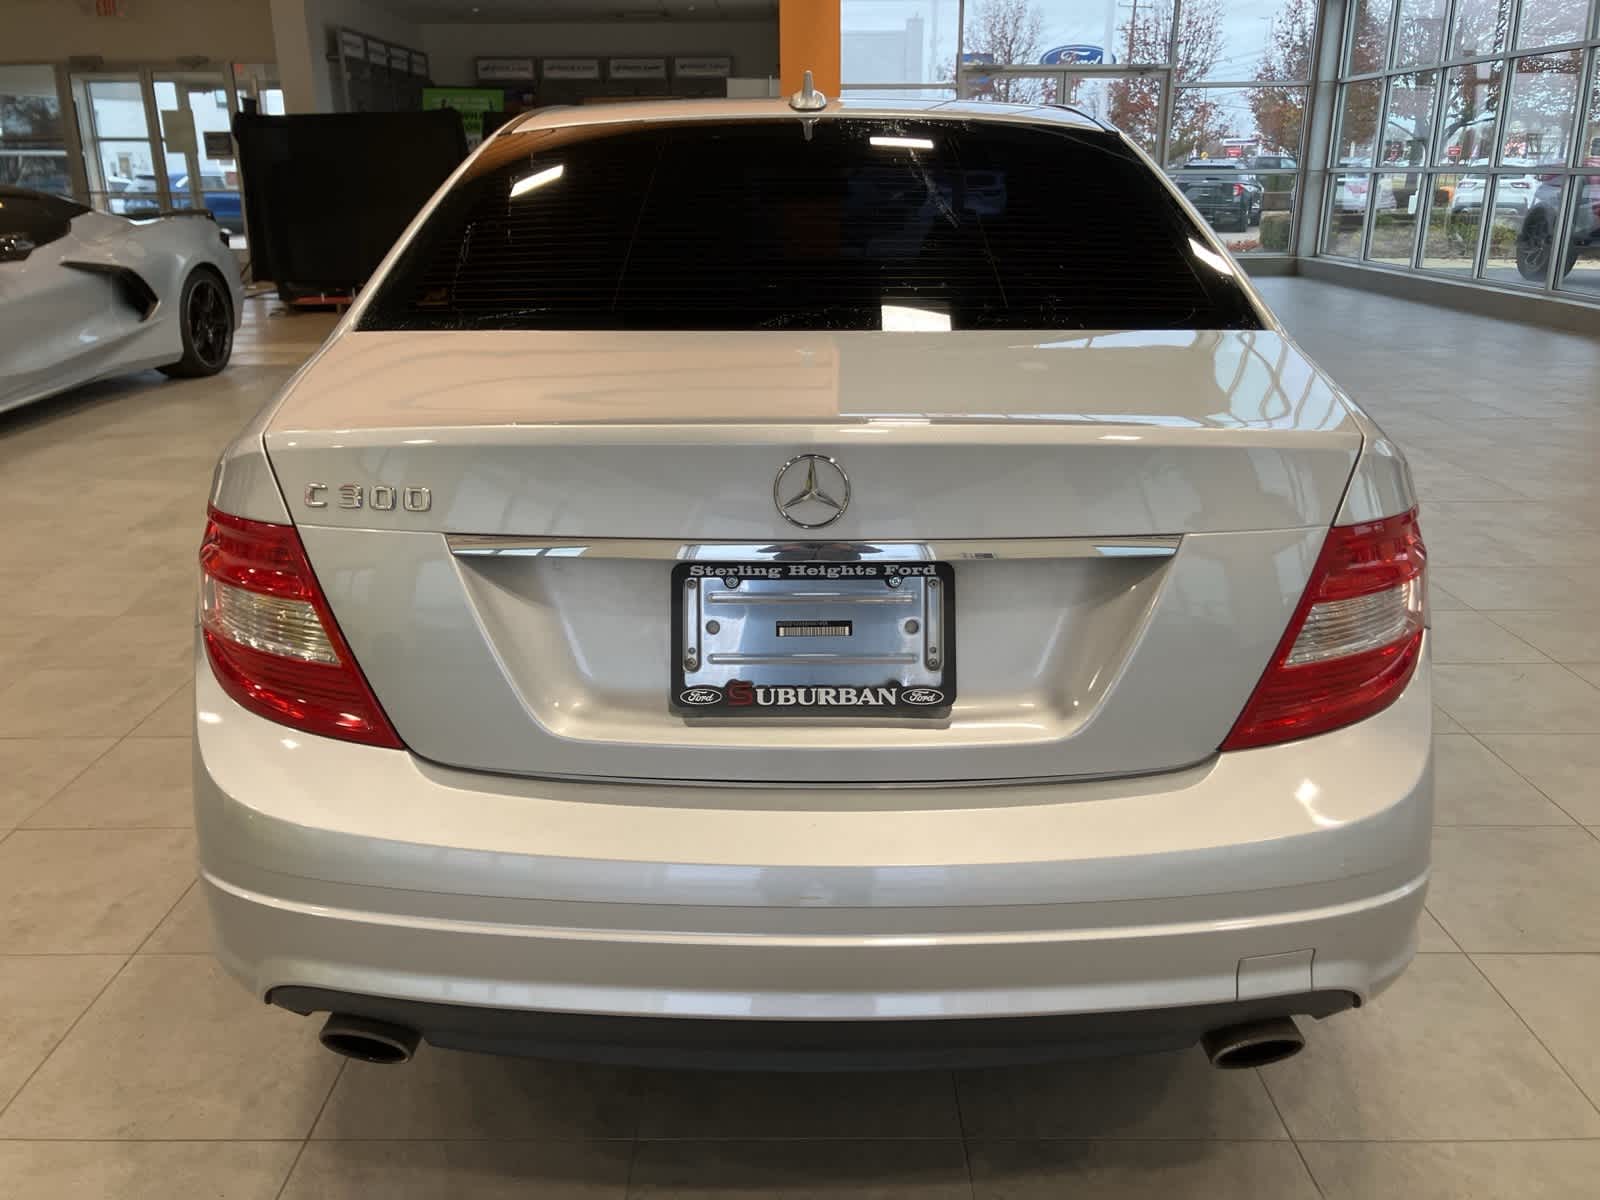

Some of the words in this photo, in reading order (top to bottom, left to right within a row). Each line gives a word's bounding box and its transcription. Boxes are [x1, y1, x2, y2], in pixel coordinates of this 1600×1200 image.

[304, 482, 328, 508] C
[338, 484, 432, 512] 300
[689, 565, 782, 579] Sterling
[788, 564, 877, 578] Heights
[883, 564, 937, 576] Ford
[687, 690, 715, 702] Ford
[727, 682, 898, 706] SUBURBAN
[908, 690, 936, 702] Ford
